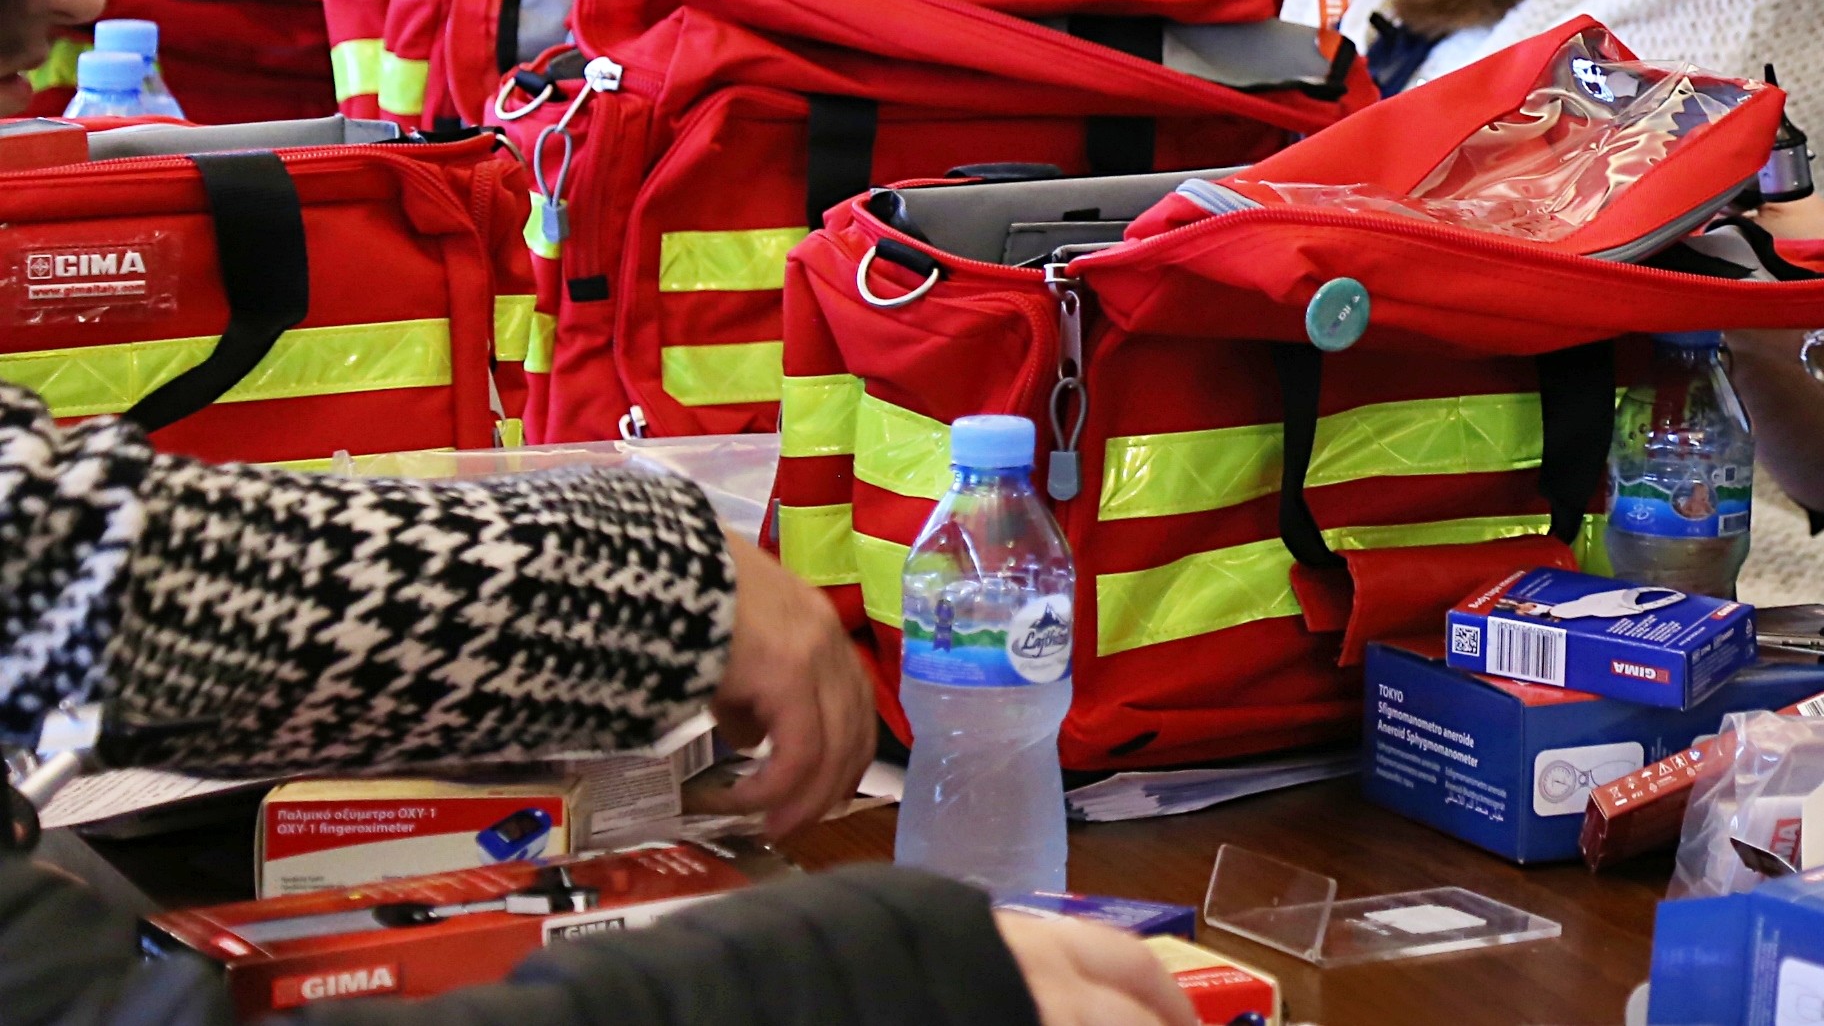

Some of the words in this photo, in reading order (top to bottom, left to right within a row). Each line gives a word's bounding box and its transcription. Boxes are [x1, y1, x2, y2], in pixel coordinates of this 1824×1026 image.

[55, 250, 146, 277] GIMA
[1612, 661, 1657, 680] GIMA
[1378, 683, 1404, 703] TOKYO
[1377, 719, 1405, 742] Aneroid
[1406, 729, 1478, 768] Sphygmomanometer
[1443, 727, 1475, 748] aneroide
[319, 823, 415, 836] fingeroximeter
[302, 967, 394, 999] GIMA
